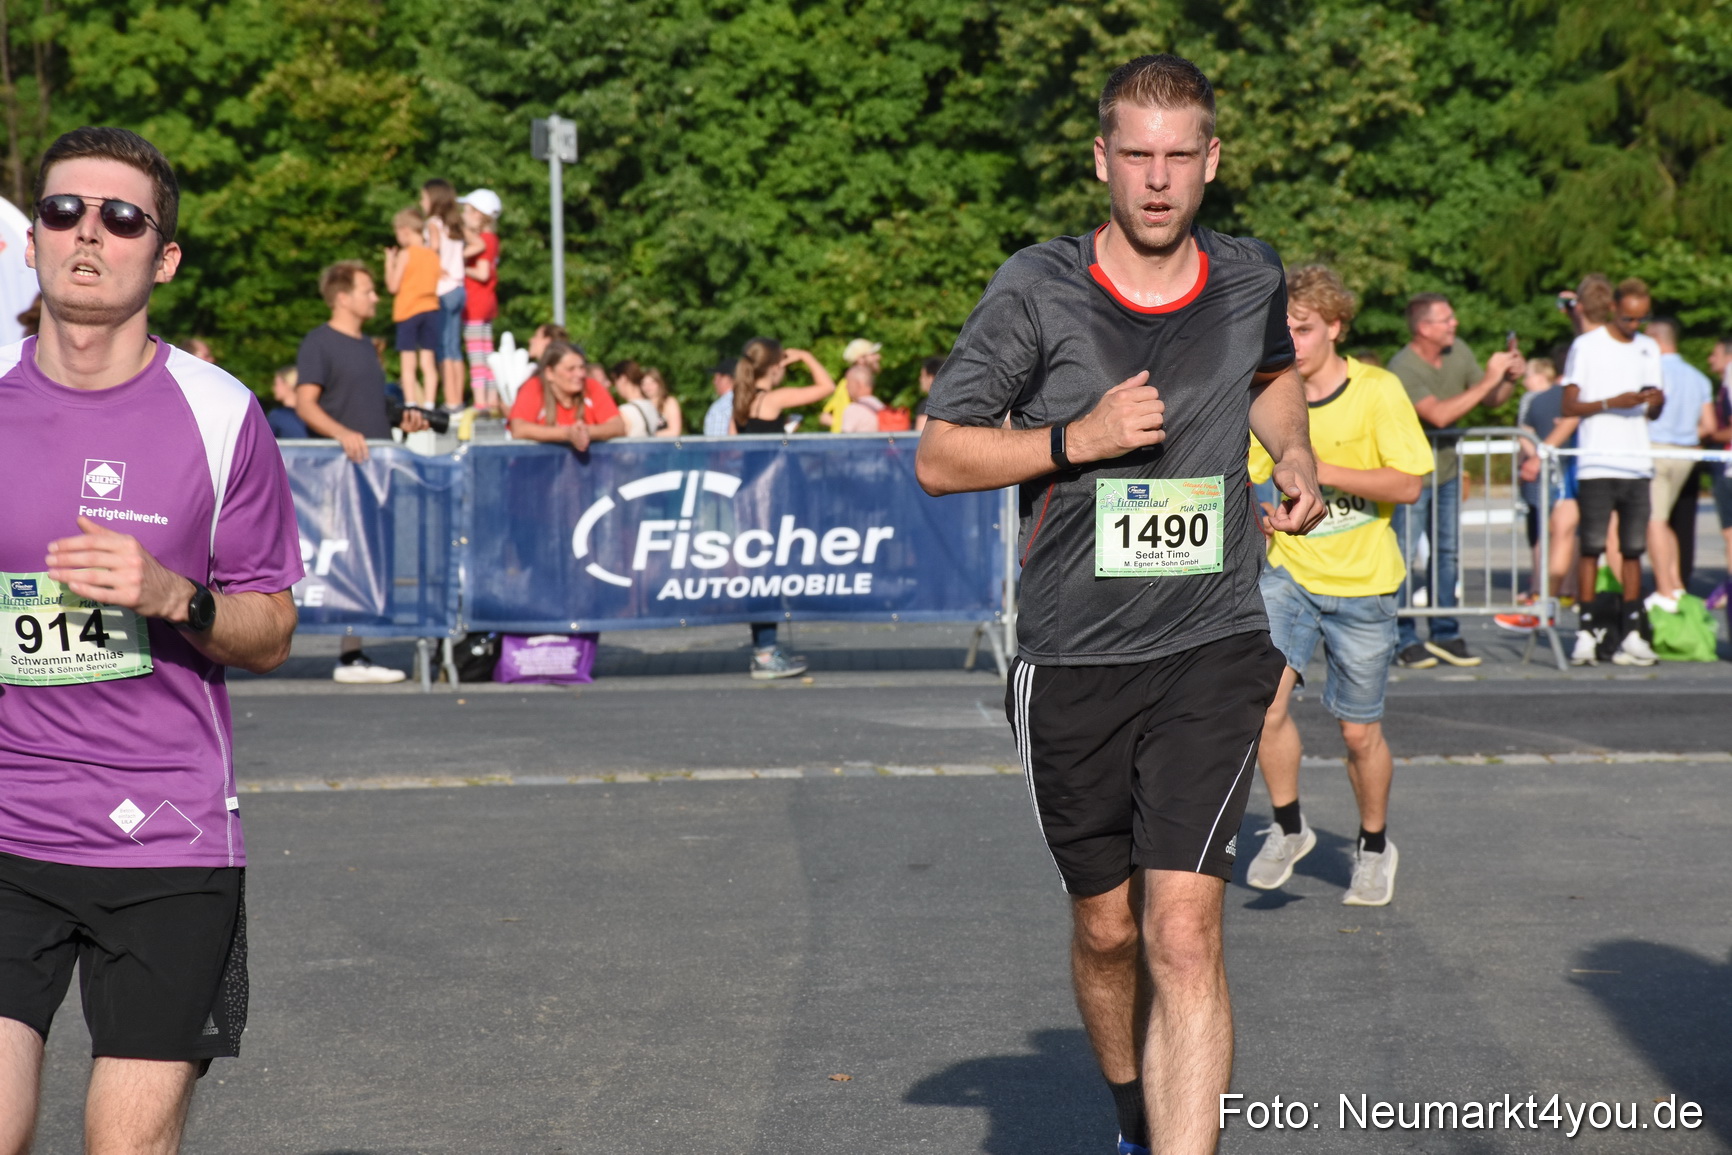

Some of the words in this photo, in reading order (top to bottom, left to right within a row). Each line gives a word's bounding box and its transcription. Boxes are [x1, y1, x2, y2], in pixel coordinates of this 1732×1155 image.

[85, 474, 121, 486] FUCHS
[1117, 498, 1169, 508] firmenlauf
[1197, 502, 1217, 512] 2019
[79, 505, 168, 525] Fertigteilwerke
[1115, 513, 1208, 548] 1490
[632, 514, 894, 571] Fischer
[1135, 551, 1163, 559] Sedat
[1166, 550, 1190, 558] Timo
[657, 573, 873, 600] AUTOMOBILE
[3, 593, 63, 606] firmenlauf
[15, 608, 110, 654] 914
[11, 655, 72, 666] Schwamm
[76, 650, 124, 663] Mathias
[18, 667, 46, 675] FUCHS
[57, 665, 84, 673] Söhne
[86, 662, 117, 671] Service
